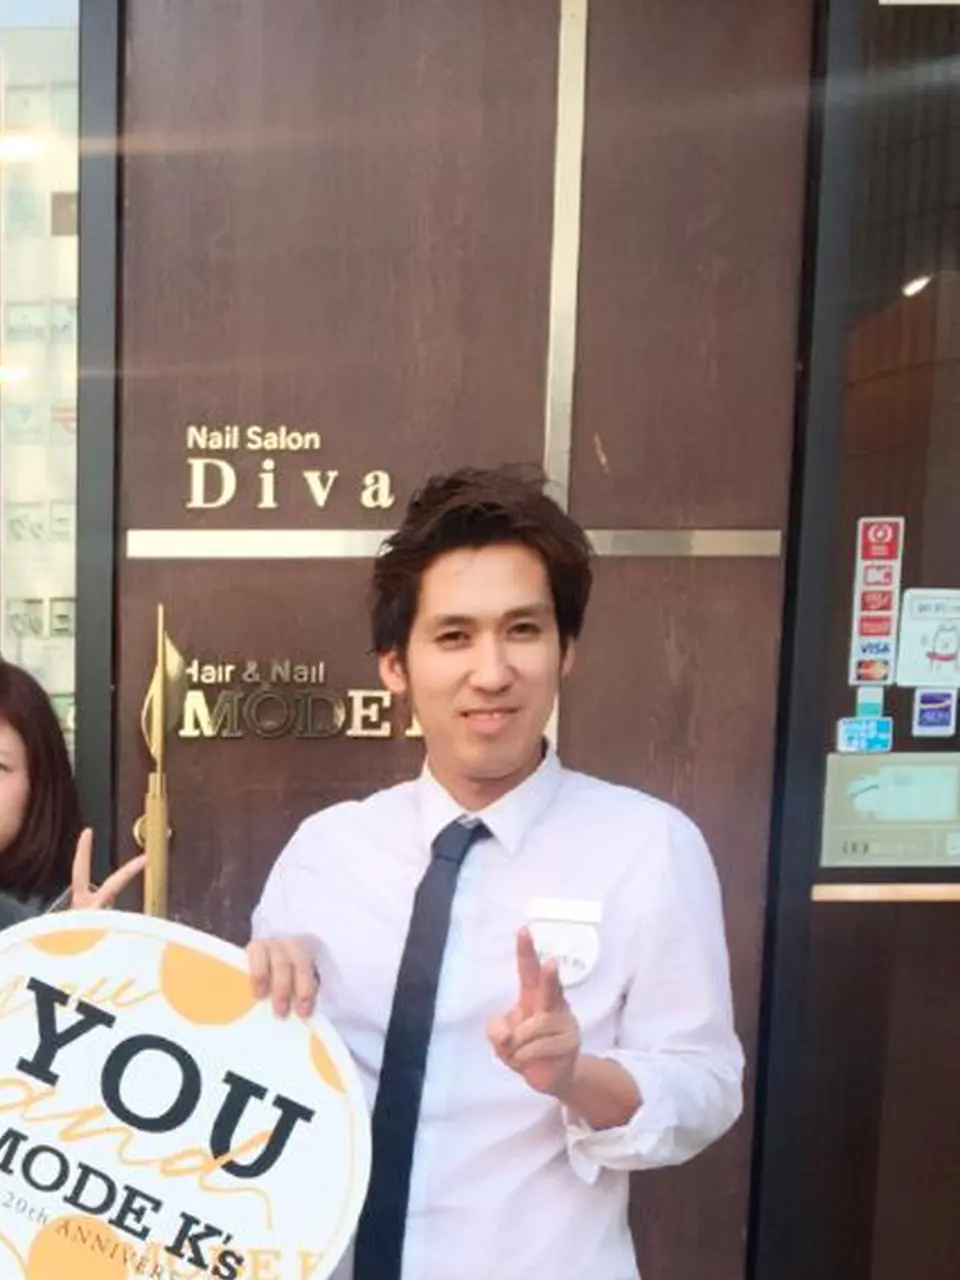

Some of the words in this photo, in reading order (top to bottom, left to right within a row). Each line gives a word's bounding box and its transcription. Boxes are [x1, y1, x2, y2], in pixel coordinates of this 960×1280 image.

[187, 426, 239, 450] Nail
[246, 426, 320, 450] Salon
[186, 457, 395, 509] Diva
[242, 661, 260, 683] &
[270, 661, 325, 683] Nail
[179, 690, 391, 738] MODE
[16, 976, 316, 1179] YOU
[1, 1190, 48, 1225] 20th
